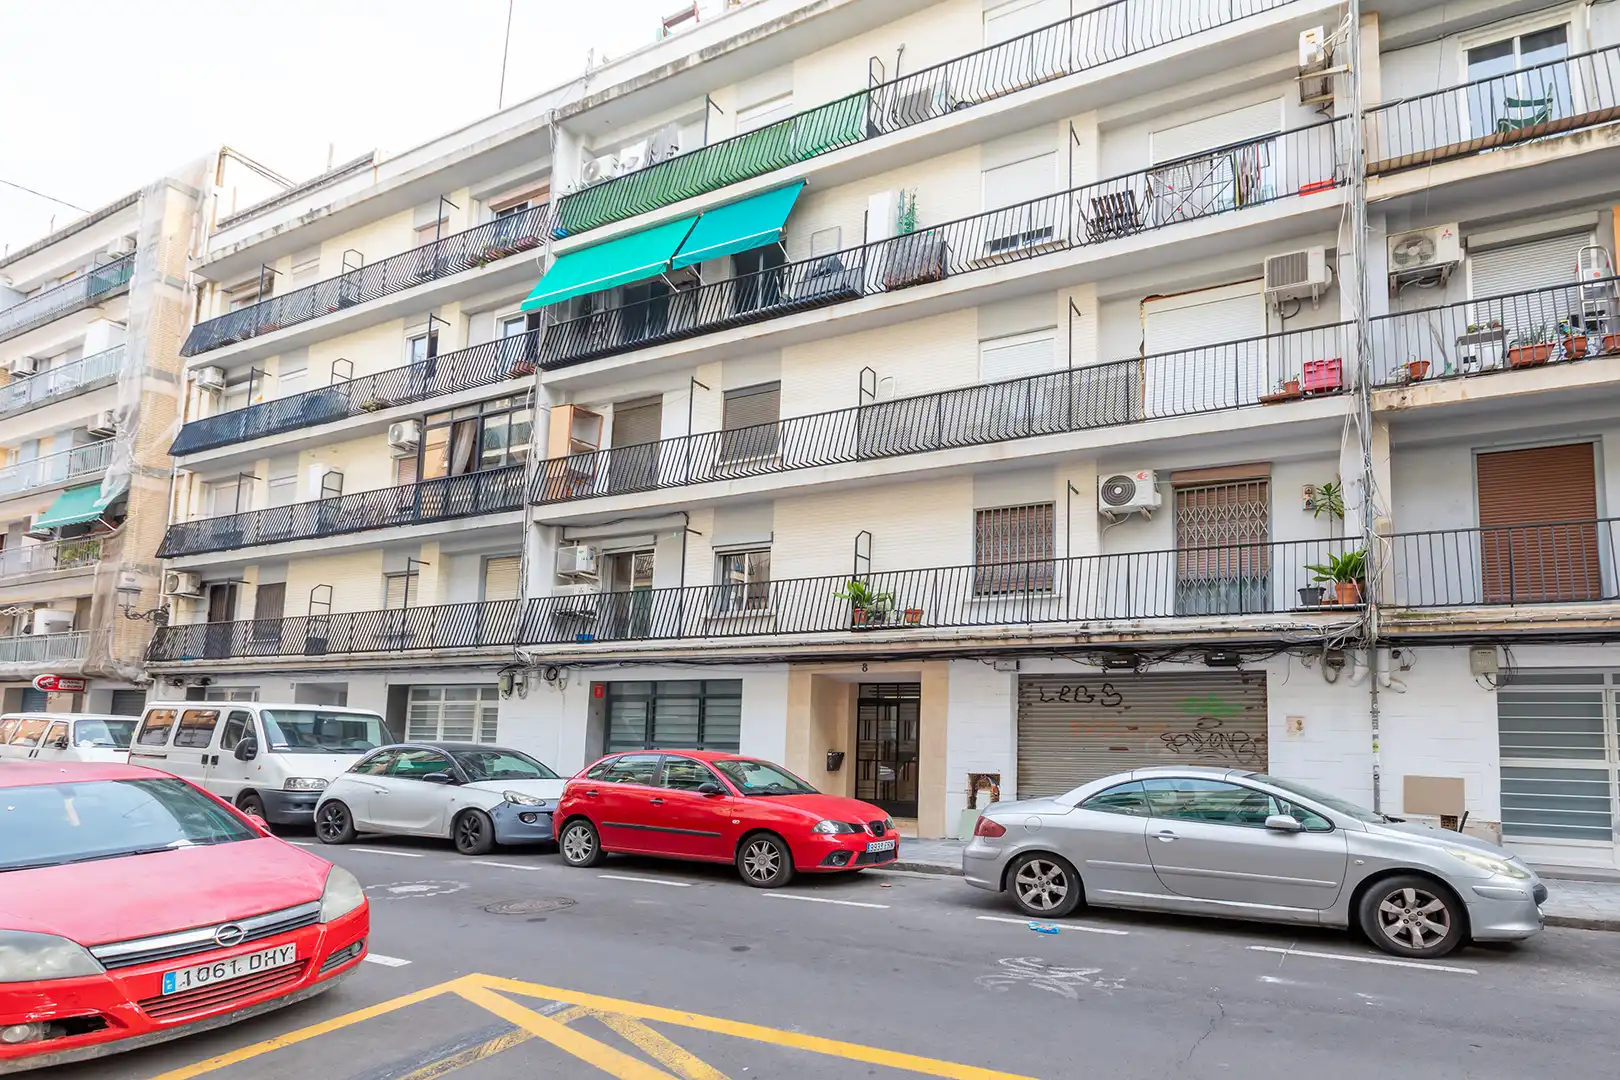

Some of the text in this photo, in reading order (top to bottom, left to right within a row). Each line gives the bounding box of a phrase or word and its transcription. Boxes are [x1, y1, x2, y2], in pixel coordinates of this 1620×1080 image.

[861, 662, 869, 673] 8
[182, 946, 290, 987] 1061 DHY
